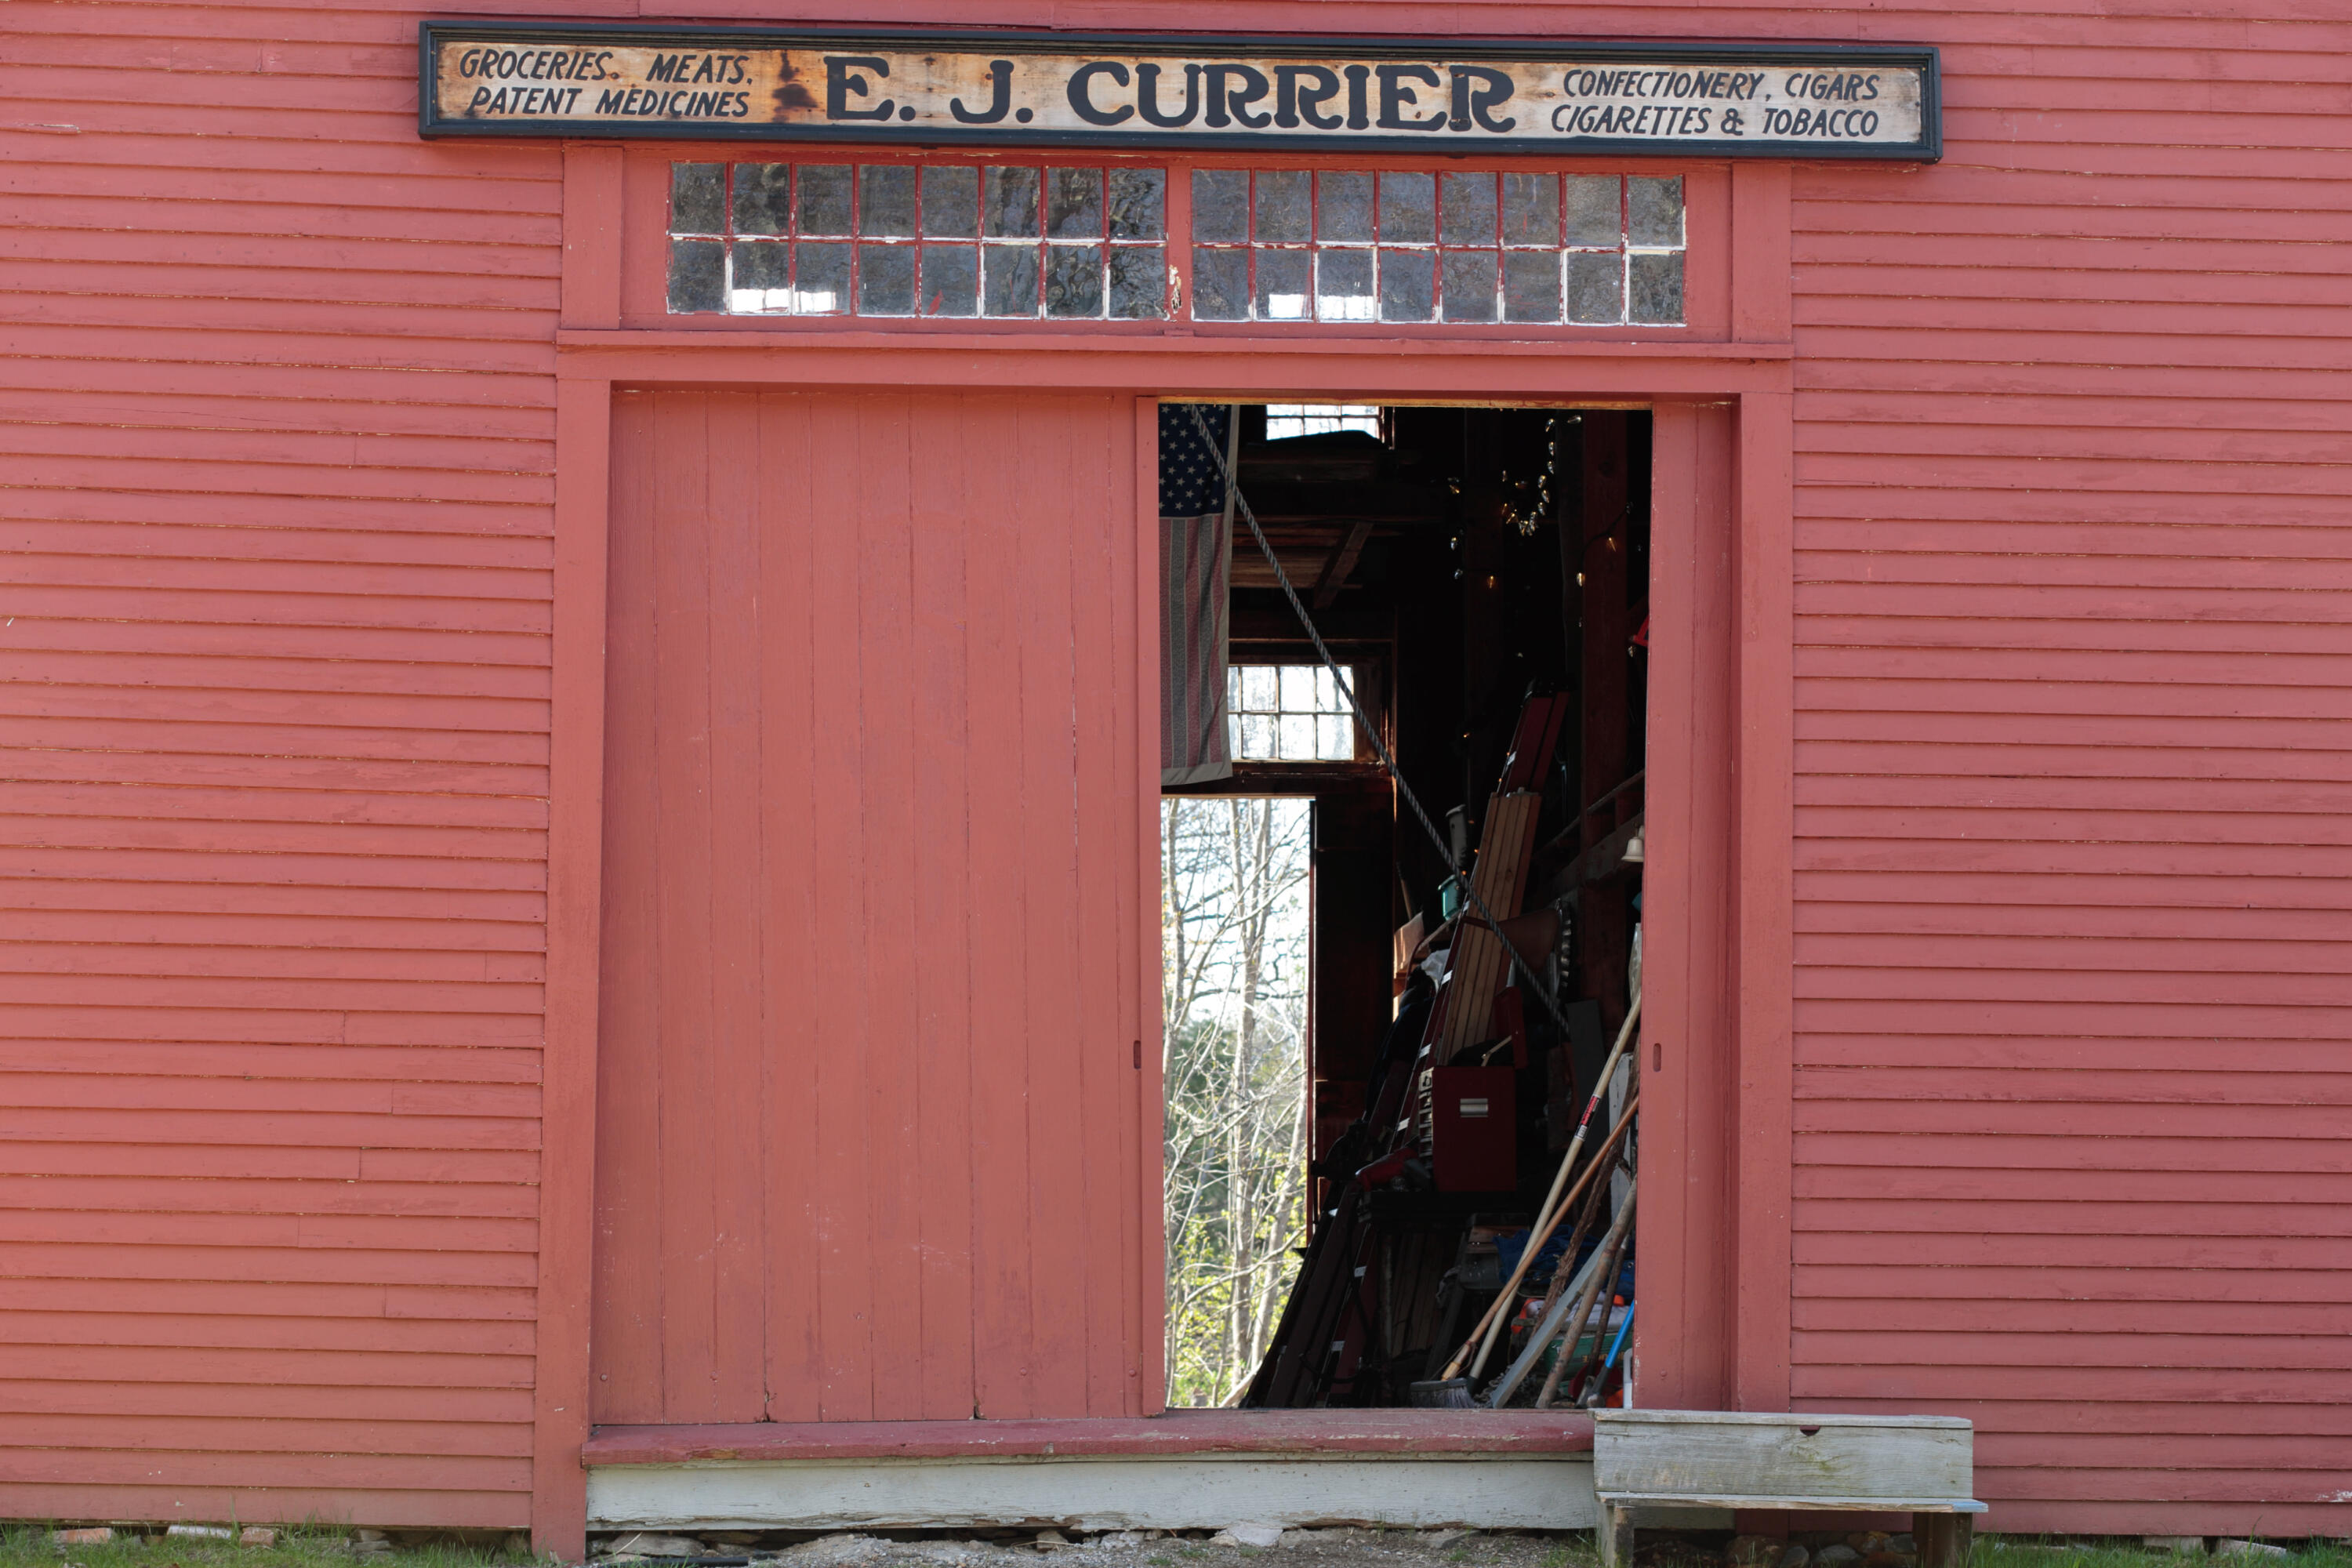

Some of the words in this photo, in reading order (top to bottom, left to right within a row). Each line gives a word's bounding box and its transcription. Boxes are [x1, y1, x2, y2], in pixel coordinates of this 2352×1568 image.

[645, 53, 753, 85] MEATS,
[1563, 69, 1771, 102] CONFECTIONERY,
[1784, 72, 1881, 102] CIGARS
[463, 86, 583, 115] PATENT
[595, 89, 750, 118] MEDICINES
[823, 56, 916, 122] E.
[949, 60, 1033, 125] J.
[1066, 60, 1516, 132] CURRIER
[1551, 104, 1712, 136] CIGARETTES
[1720, 107, 1744, 136] &
[1762, 108, 1878, 137] TOBACCO
